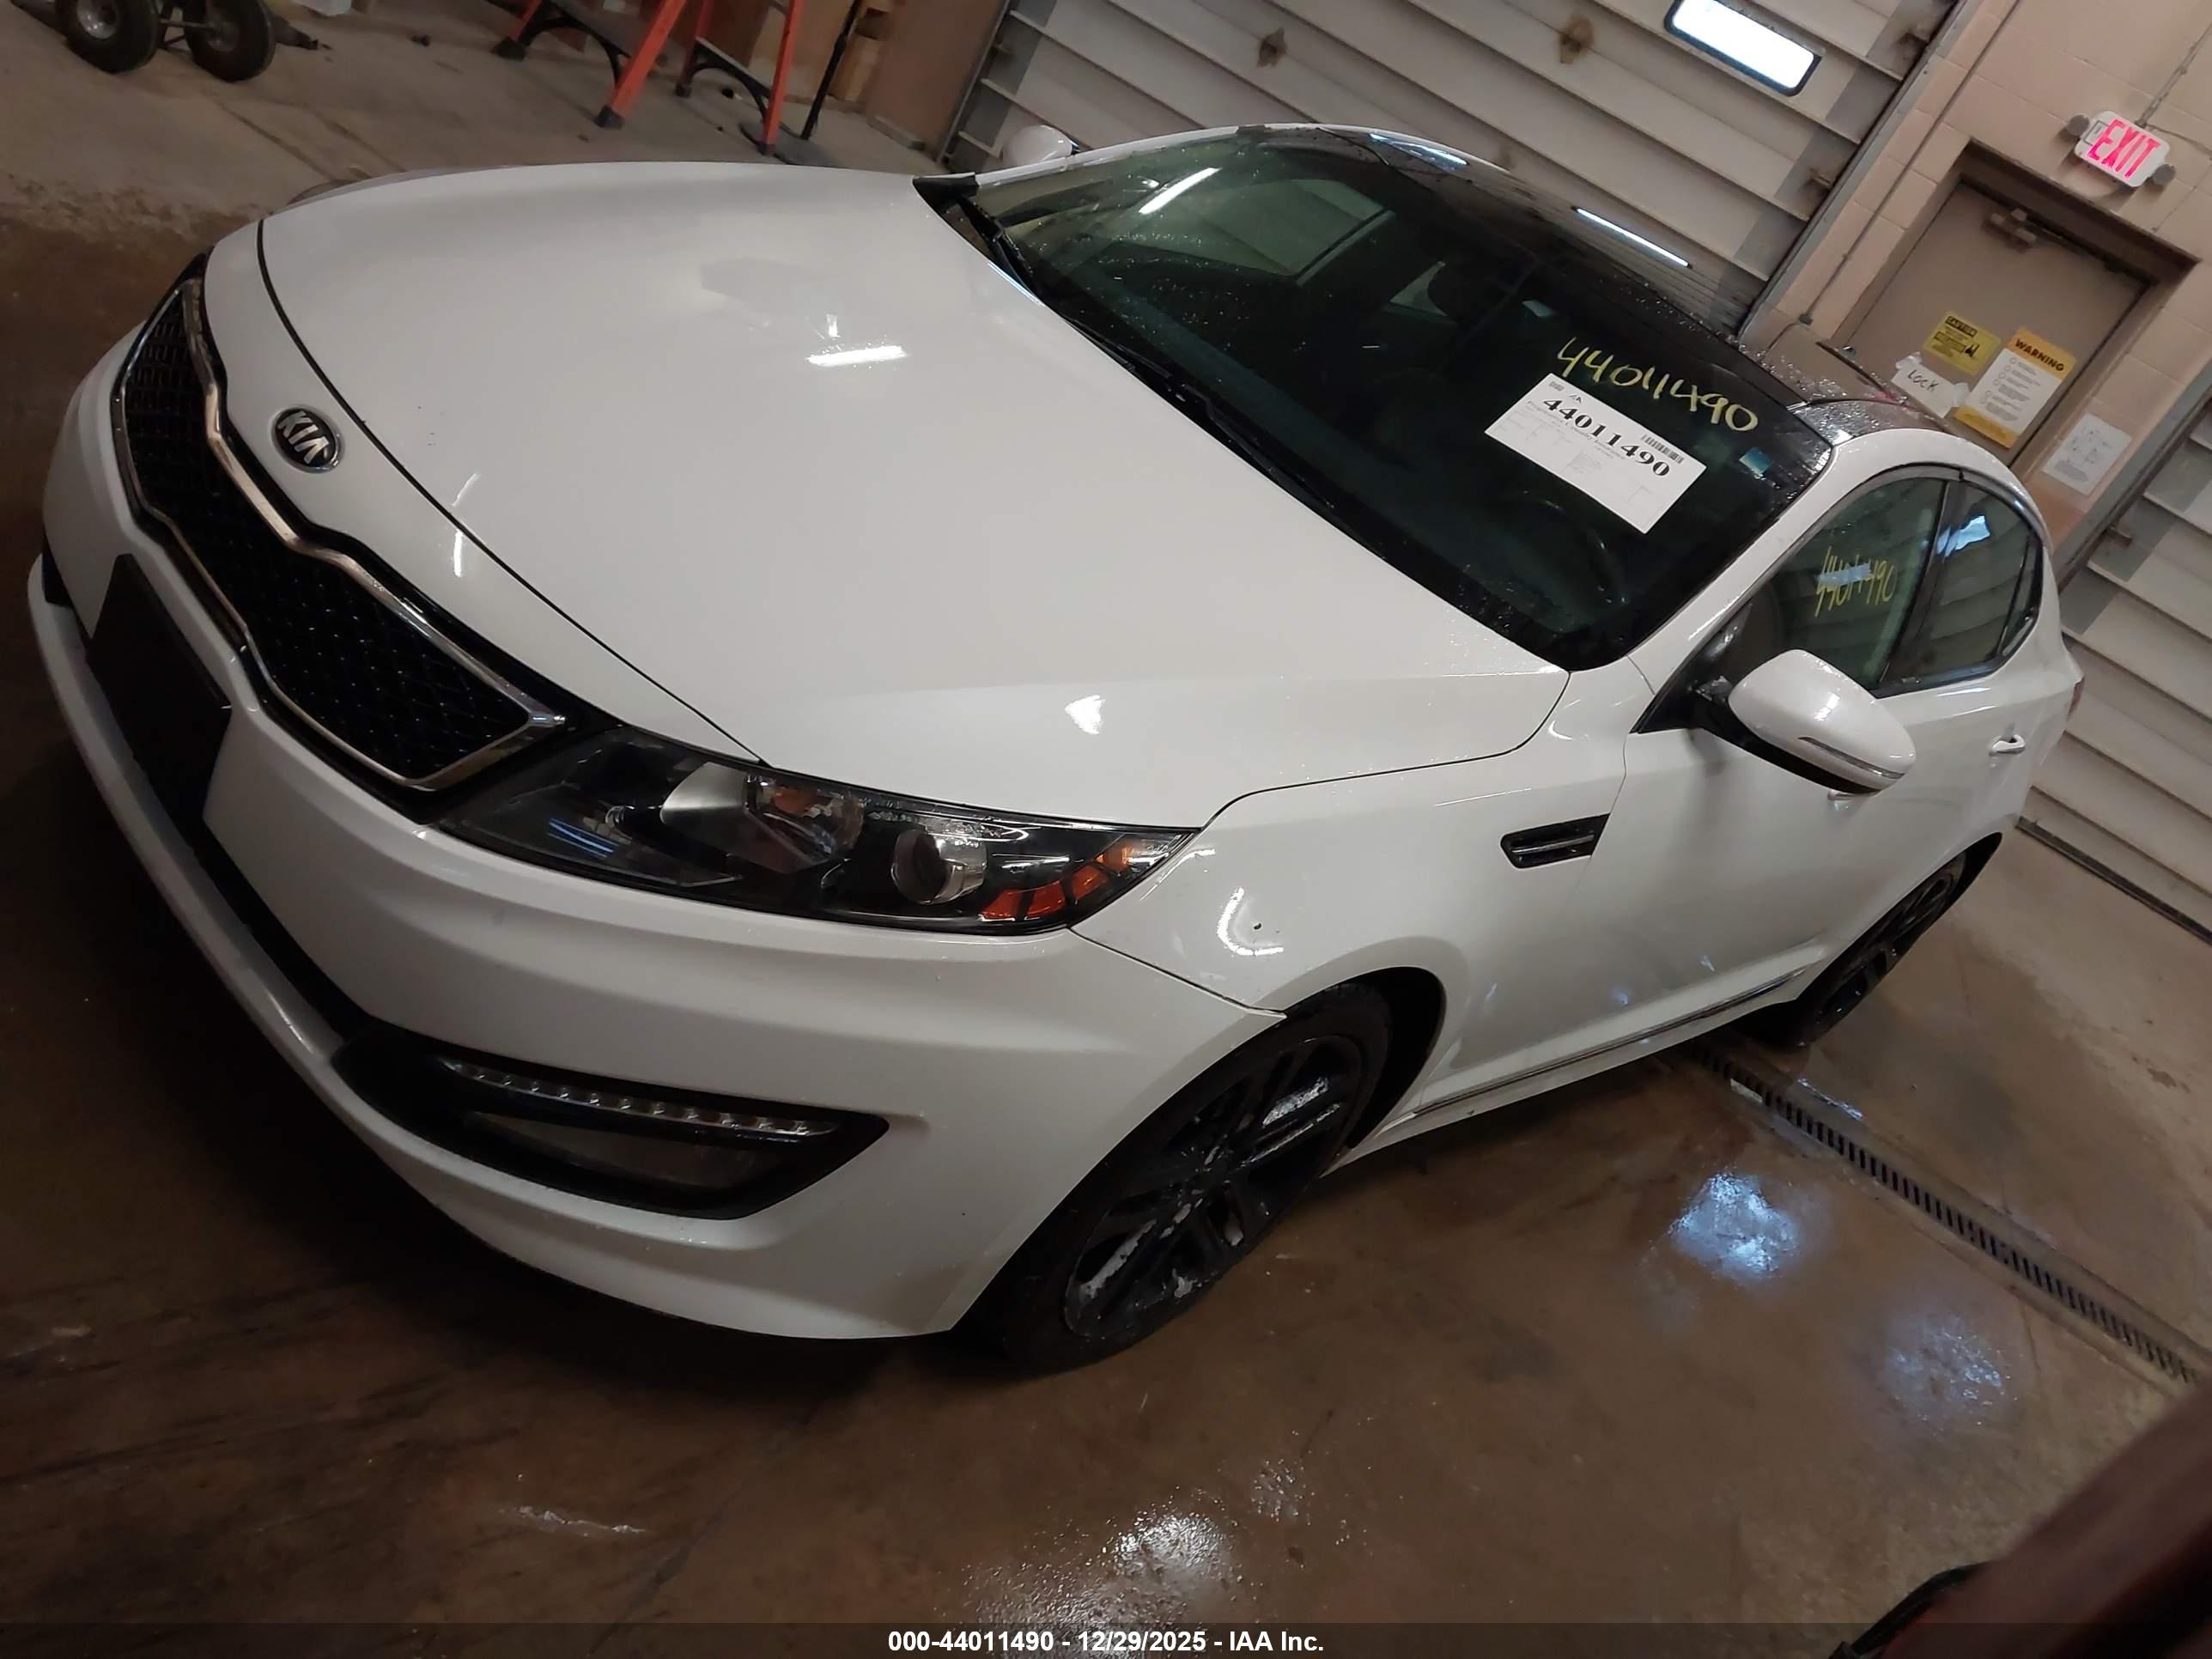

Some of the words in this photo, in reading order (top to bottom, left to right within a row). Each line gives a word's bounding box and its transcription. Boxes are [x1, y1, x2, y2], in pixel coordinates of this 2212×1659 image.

[2086, 118, 2161, 179] EXIT
[1907, 368, 1941, 393] LOCK
[2014, 338, 2065, 372] WARNING
[1557, 337, 1759, 431] 44011490
[276, 410, 330, 464] KIA
[1542, 398, 1670, 477] 44011490
